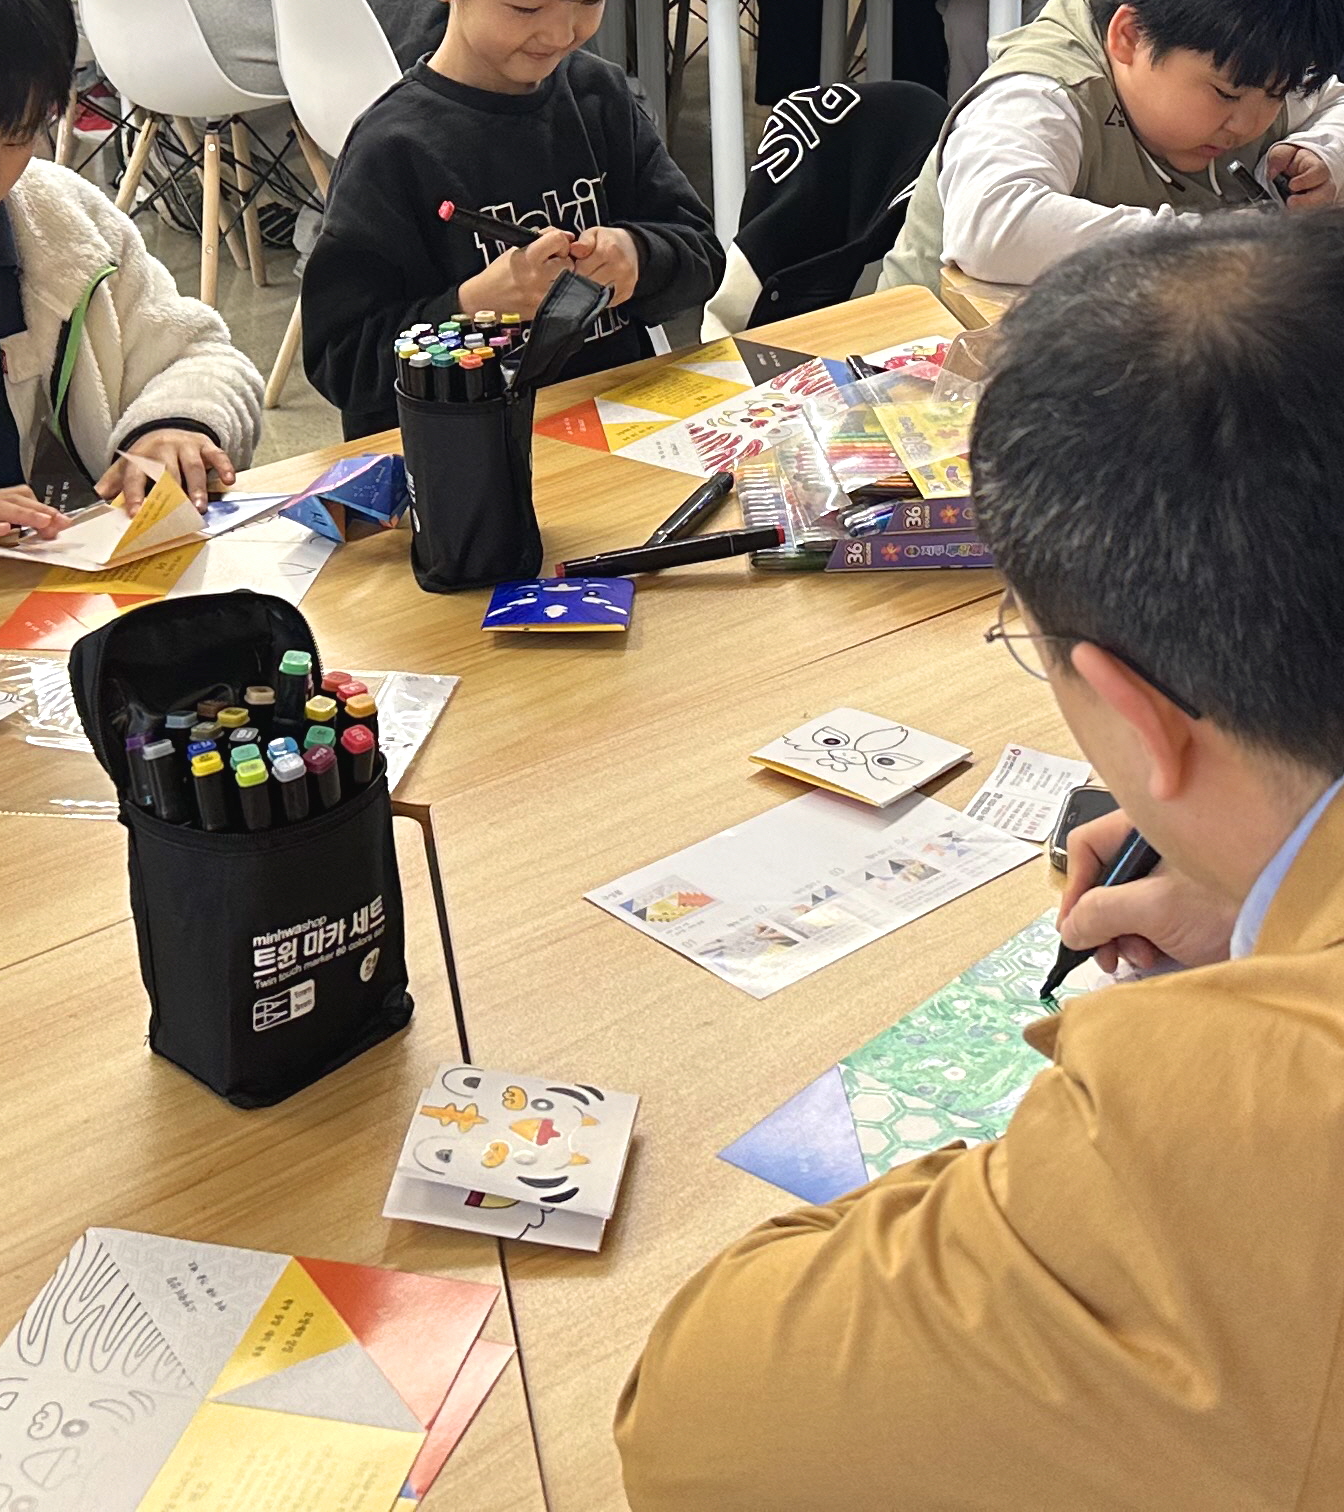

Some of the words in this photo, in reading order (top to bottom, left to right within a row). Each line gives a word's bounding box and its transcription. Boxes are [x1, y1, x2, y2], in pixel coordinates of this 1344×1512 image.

[905, 504, 922, 528] 36
[846, 541, 863, 565] 36
[253, 915, 328, 948] minhwashop
[253, 937, 298, 978] 트윈
[303, 917, 347, 957] 마카
[349, 894, 386, 938] 세트
[253, 977, 278, 990] Twin
[278, 965, 302, 983] touch
[303, 951, 334, 971] marker
[347, 934, 373, 952] colors
